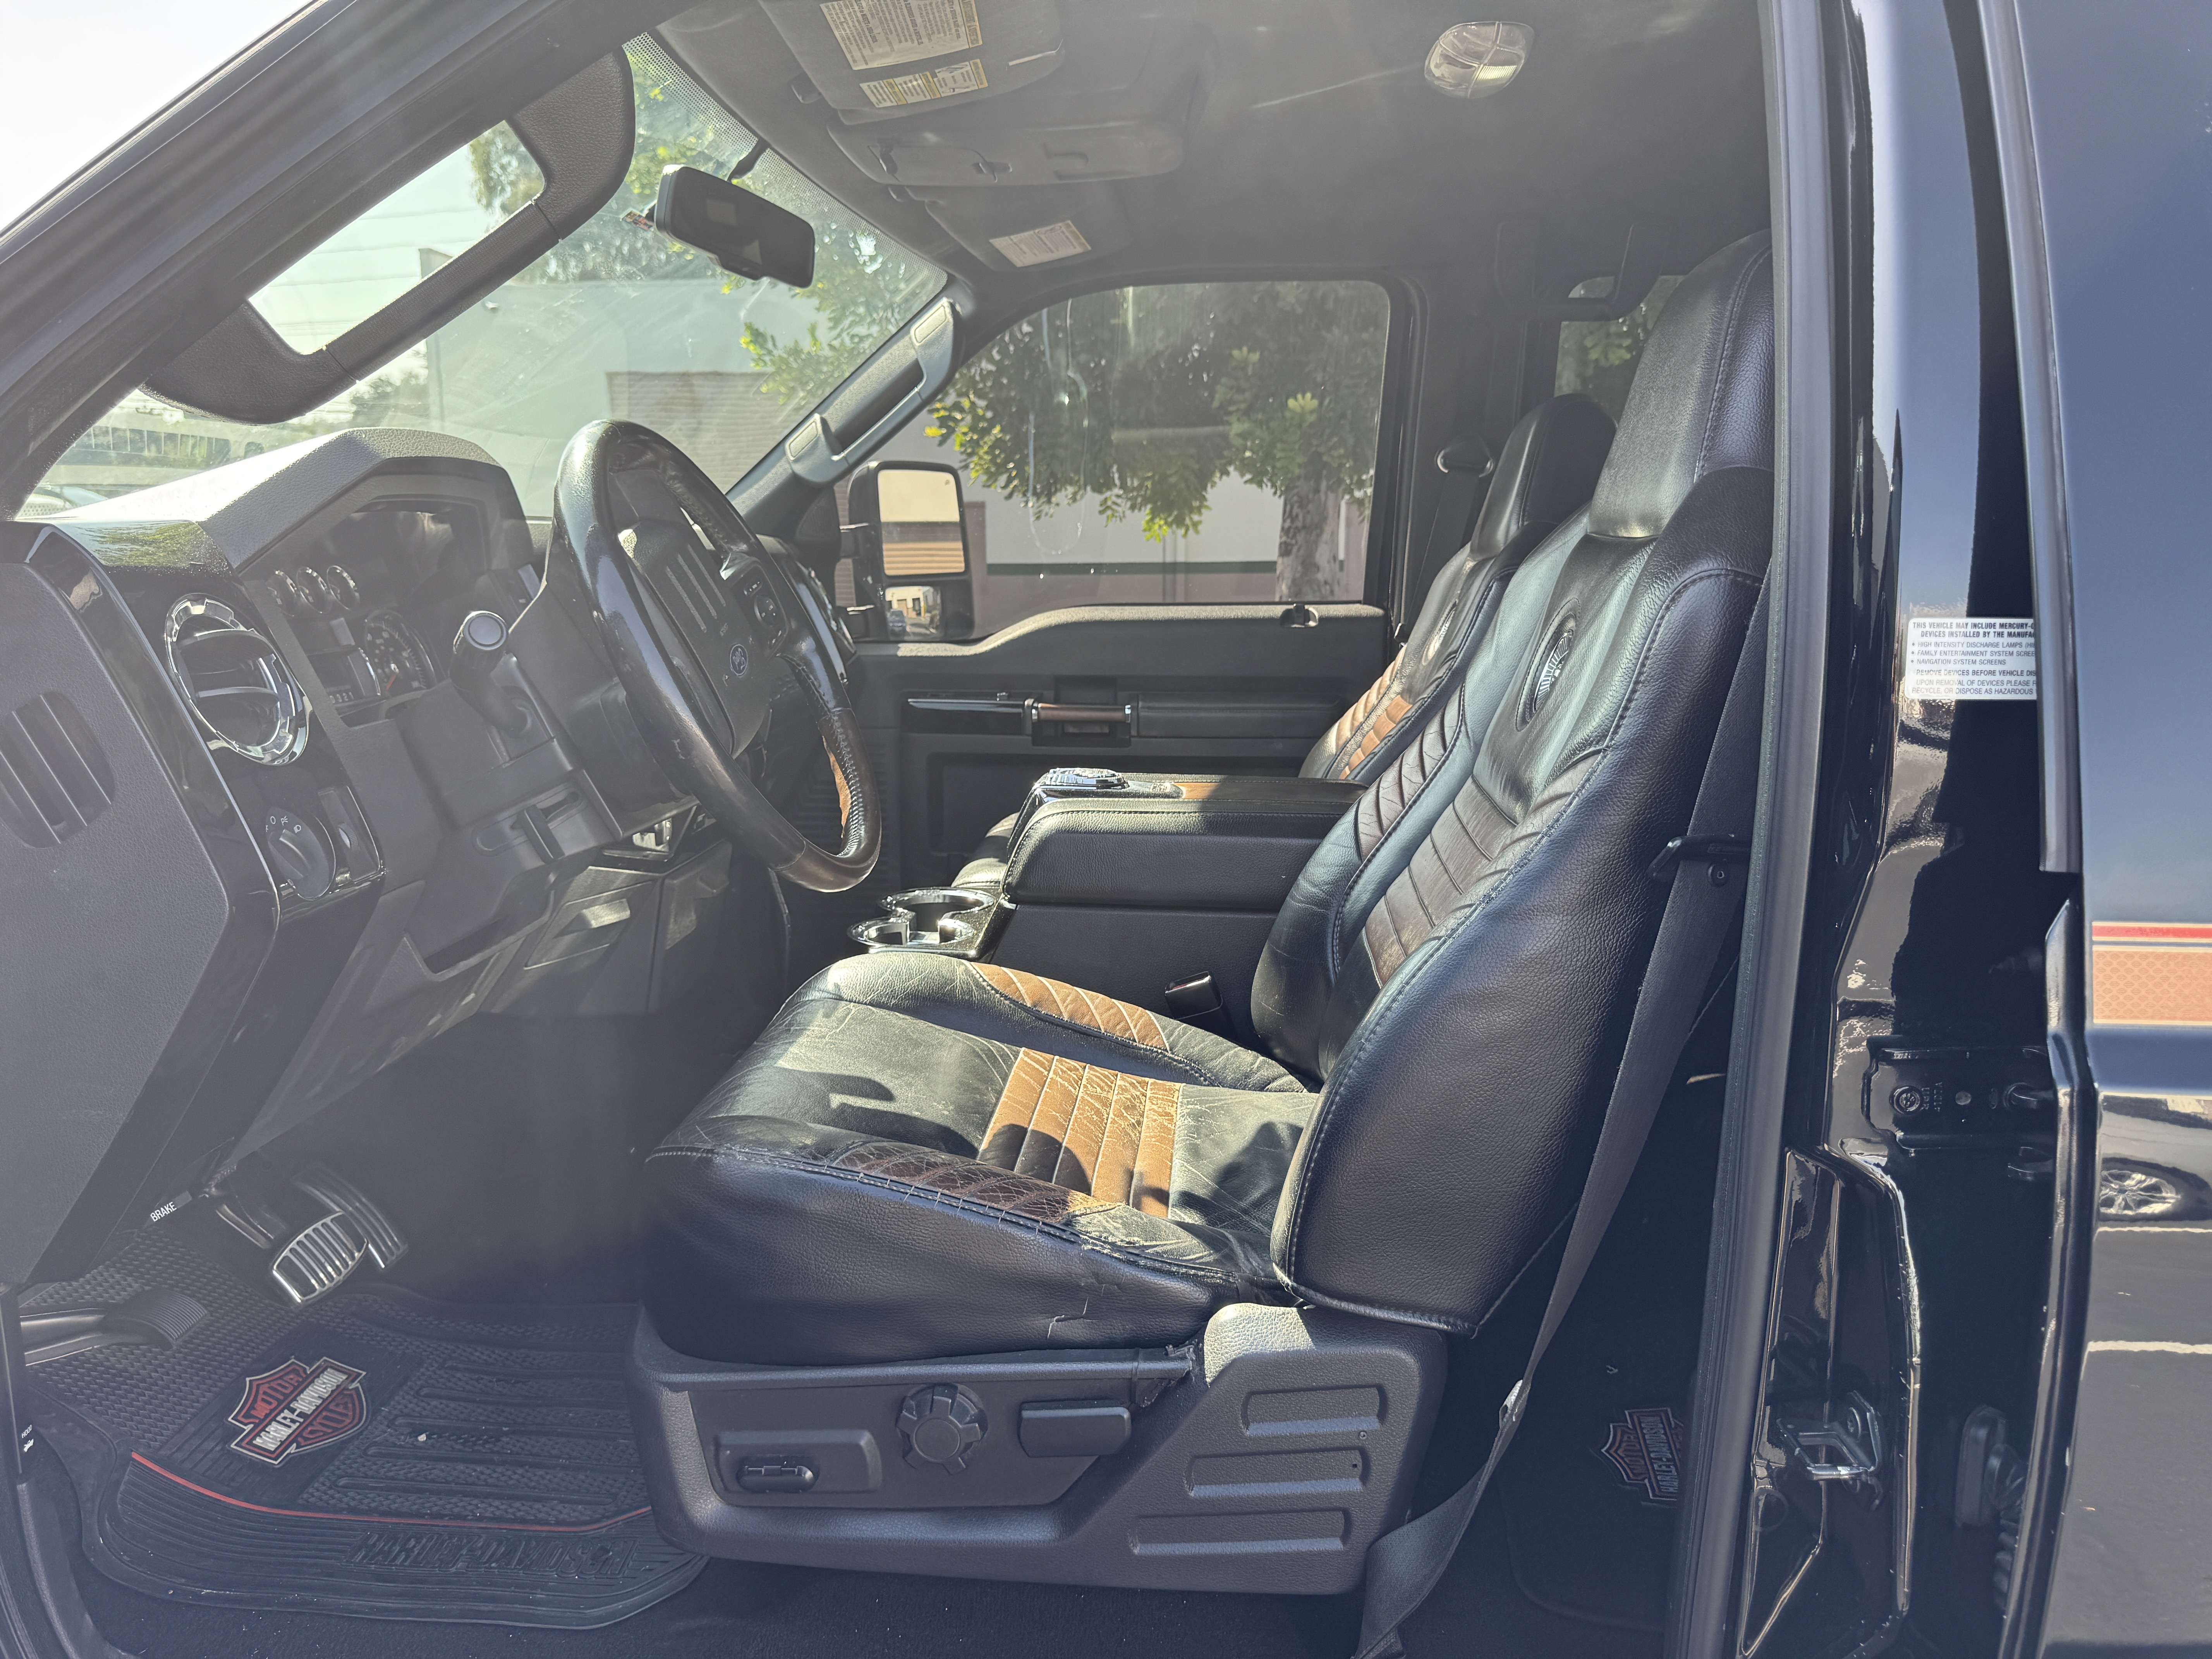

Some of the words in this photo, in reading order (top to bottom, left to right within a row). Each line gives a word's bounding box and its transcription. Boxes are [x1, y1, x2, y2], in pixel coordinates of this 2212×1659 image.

[150, 1202, 177, 1222] BRAKE
[251, 1374, 303, 1419] MOTOR
[252, 1367, 349, 1451] HARLEY-DAVIDSON
[21, 1424, 33, 1439] HOOD
